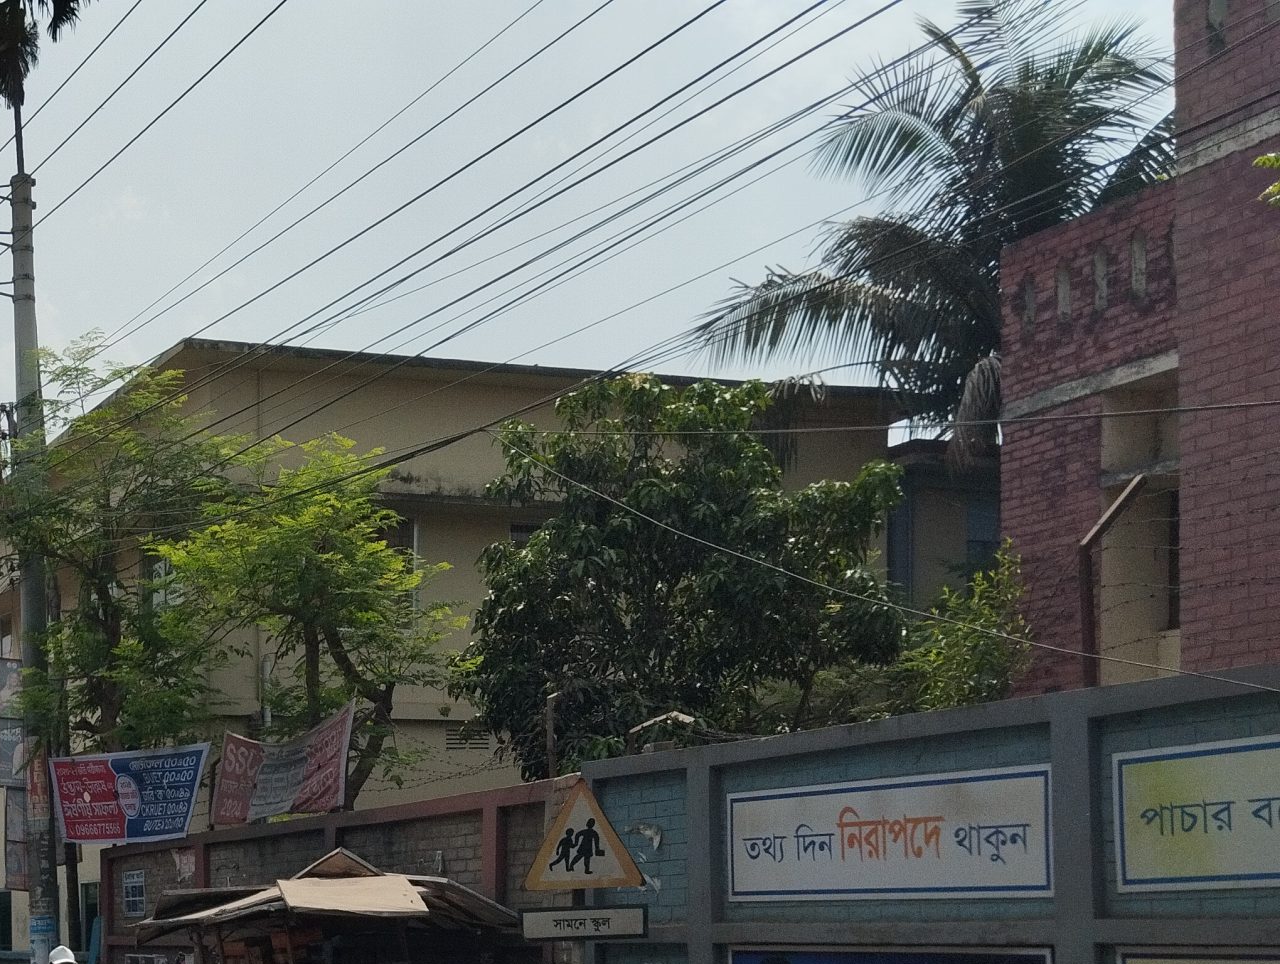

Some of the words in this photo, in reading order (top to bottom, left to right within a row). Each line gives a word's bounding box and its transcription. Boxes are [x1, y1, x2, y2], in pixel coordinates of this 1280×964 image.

[142, 772, 163, 784] BUET
[1140, 800, 1235, 838] পাচার
[743, 836, 786, 863] তথ্য
[794, 824, 835, 862] দিন
[836, 806, 946, 863] নিরাপদে
[954, 823, 1031, 864] থাকুন
[553, 918, 587, 930] সামনে
[589, 917, 611, 932] স্কুল
